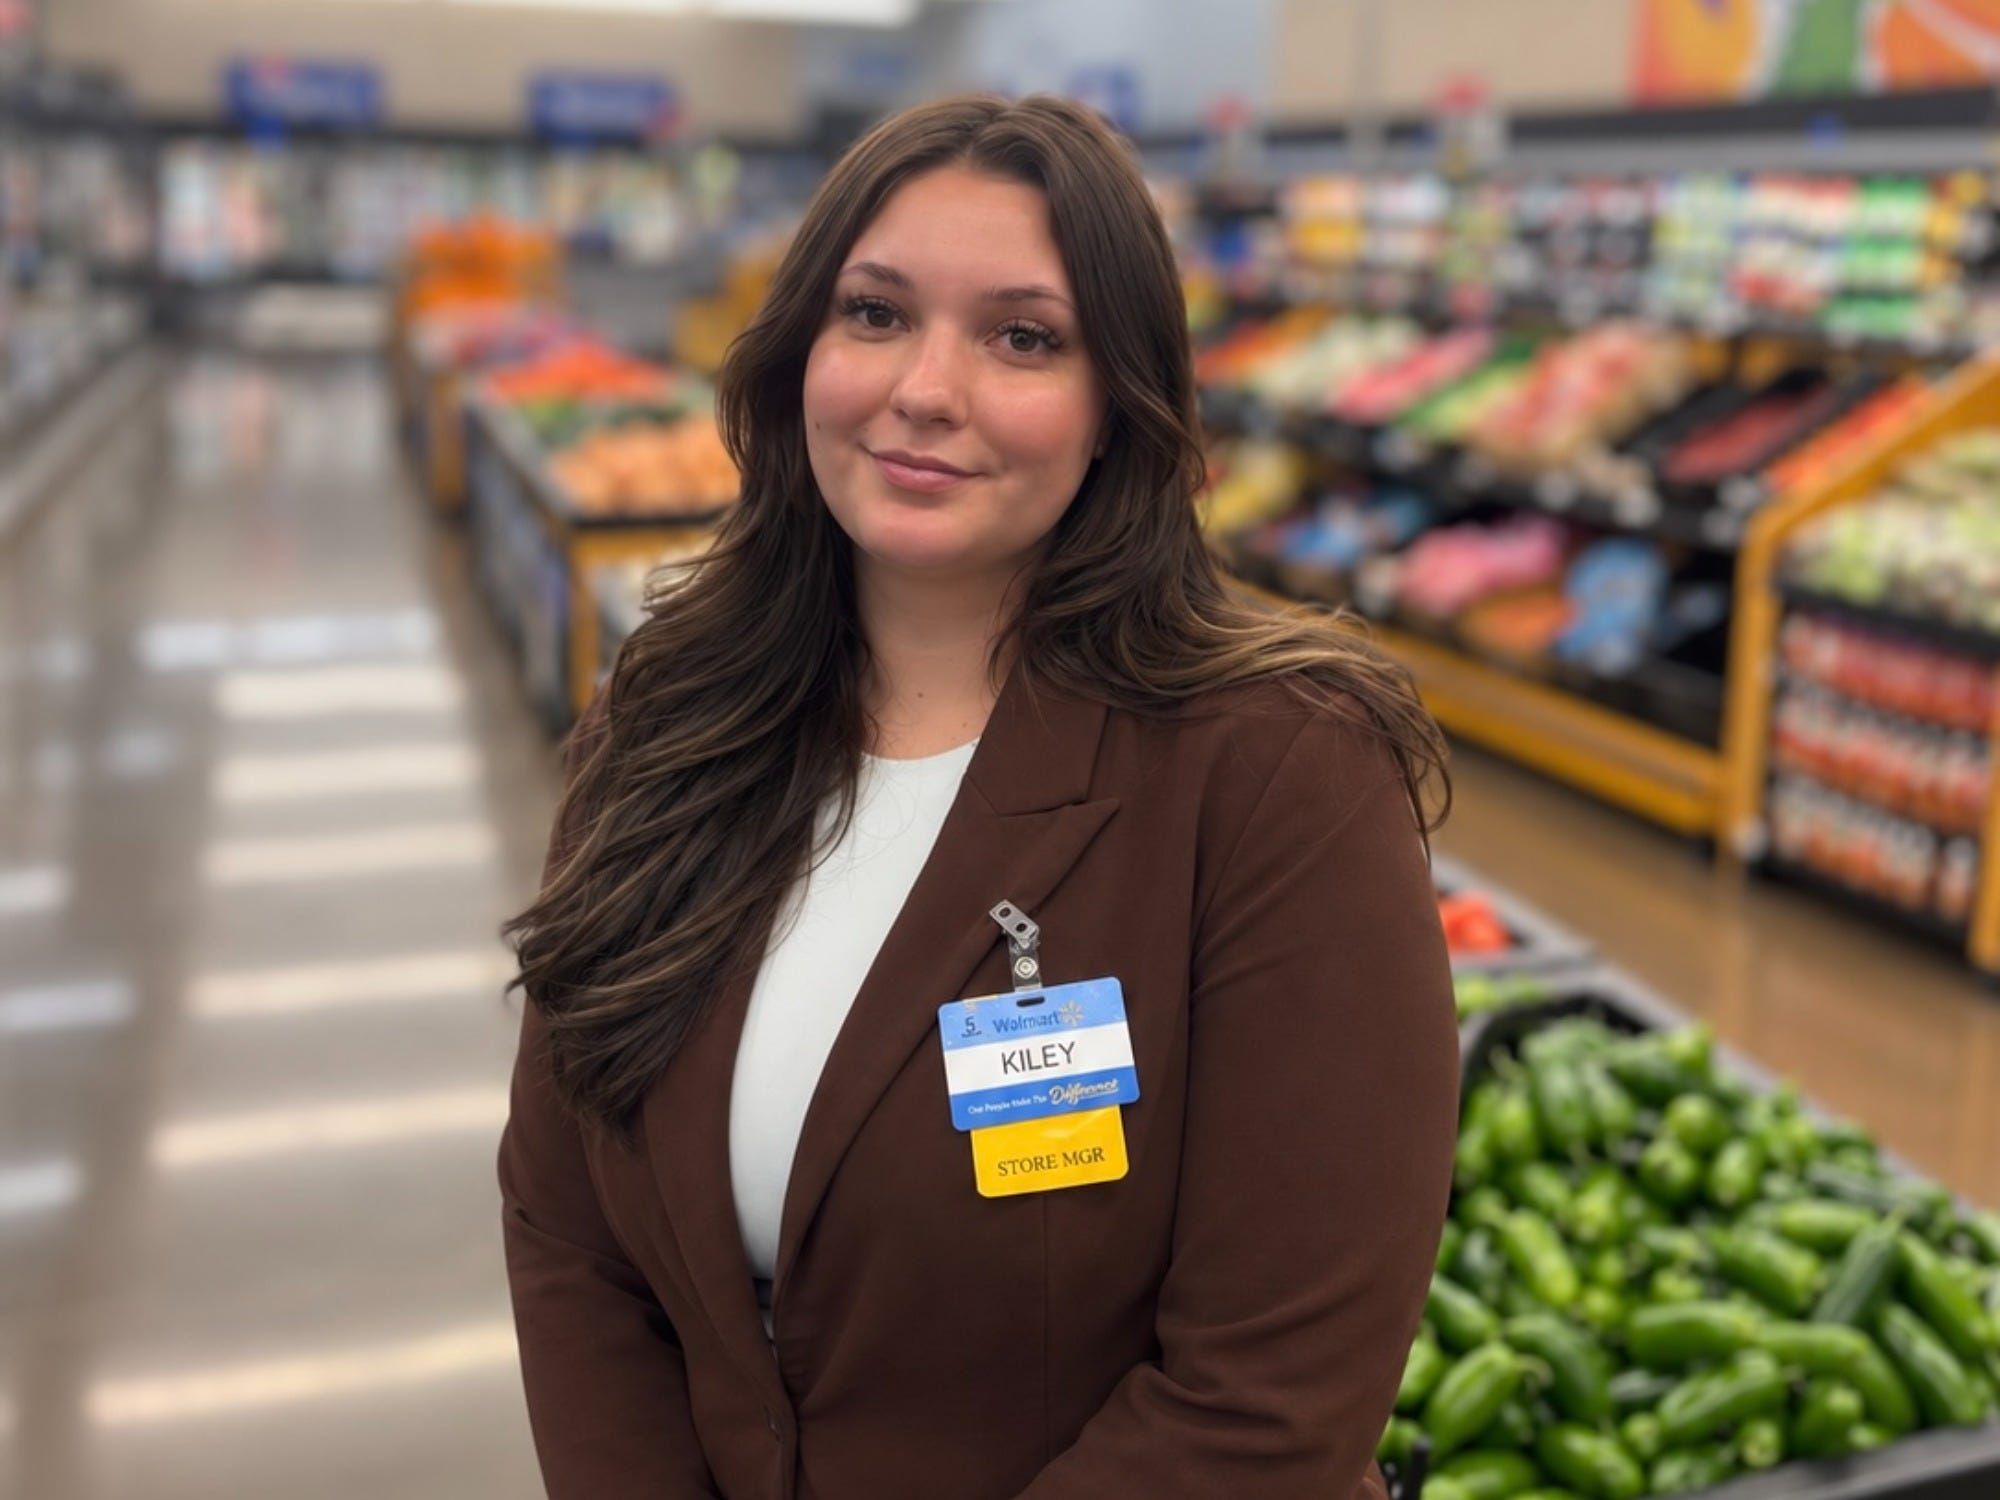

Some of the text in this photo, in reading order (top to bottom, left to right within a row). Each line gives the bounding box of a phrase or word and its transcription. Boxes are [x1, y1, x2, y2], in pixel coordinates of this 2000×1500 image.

[992, 1010, 1060, 1033] Walmart
[1001, 1041, 1076, 1075] KILEY
[1049, 1078, 1119, 1105] Difference
[997, 1146, 1105, 1177] STORE MGR
